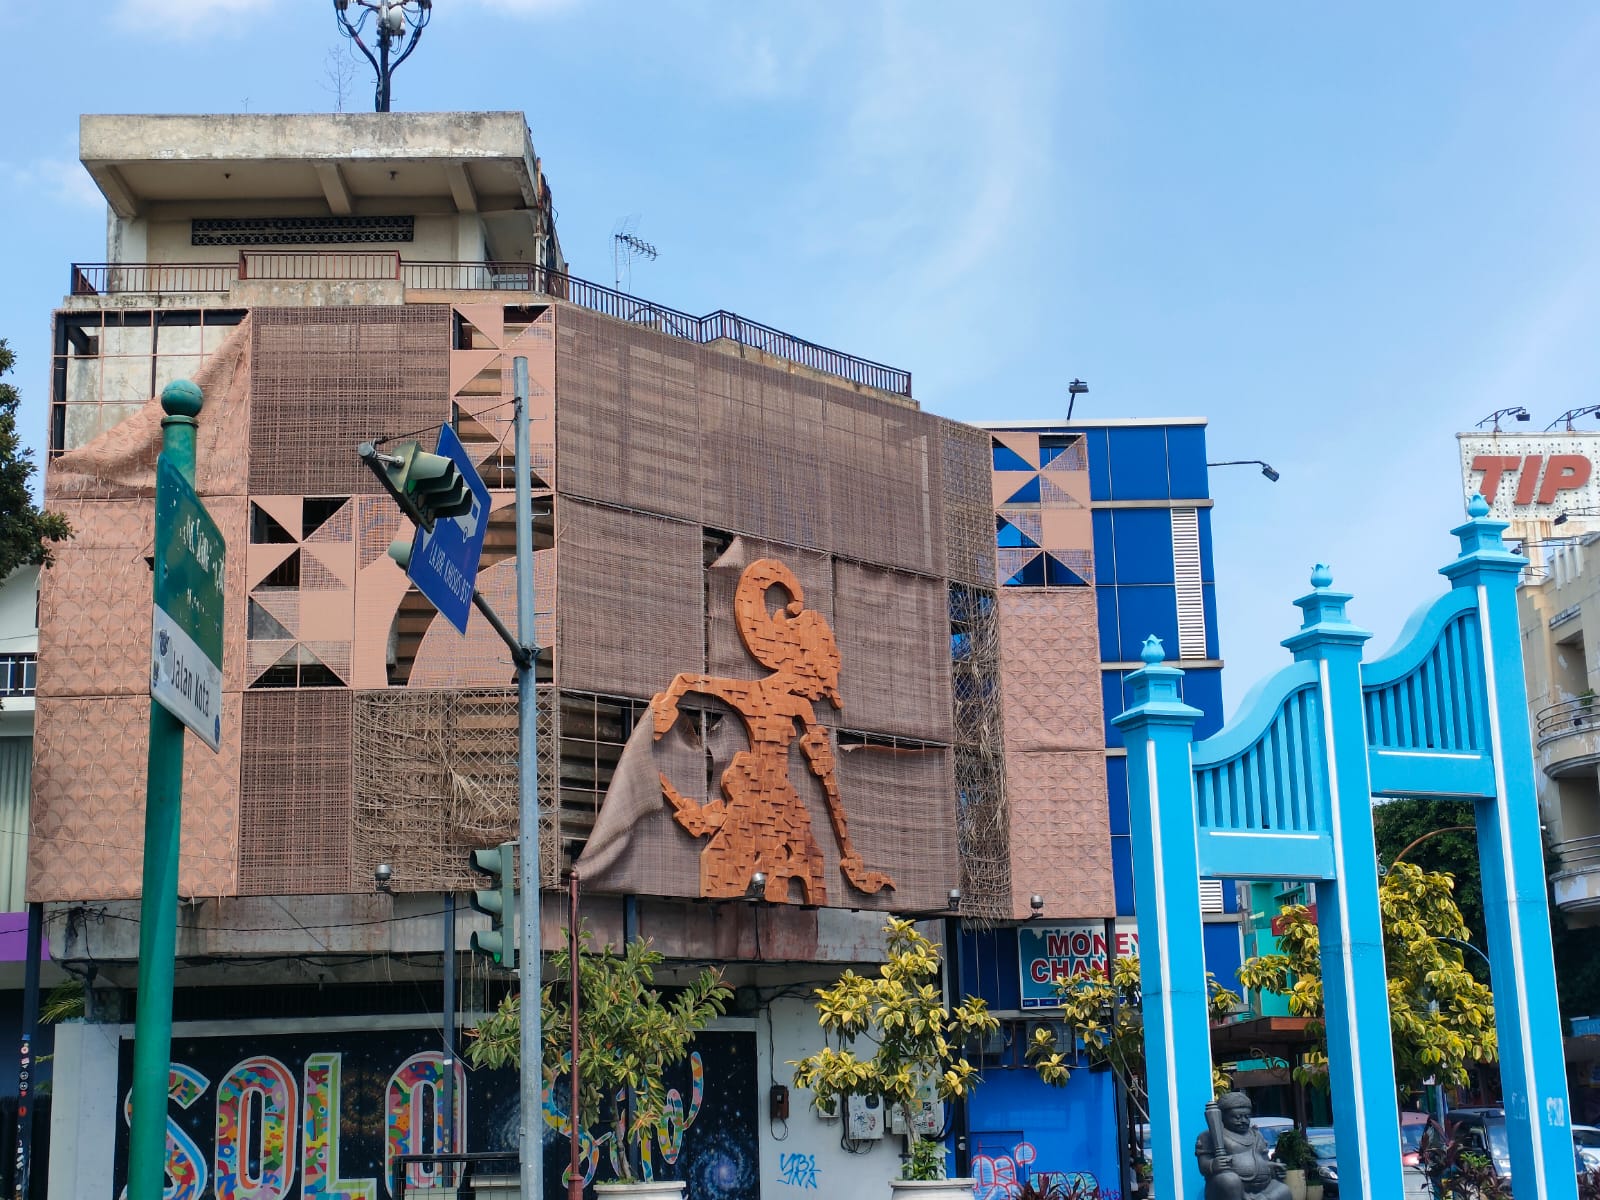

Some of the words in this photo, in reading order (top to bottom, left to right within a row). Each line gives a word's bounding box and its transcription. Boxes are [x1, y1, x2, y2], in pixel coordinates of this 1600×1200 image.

[1471, 454, 1593, 506] TIP
[171, 650, 193, 702] Jalan
[194, 672, 210, 718] Kota
